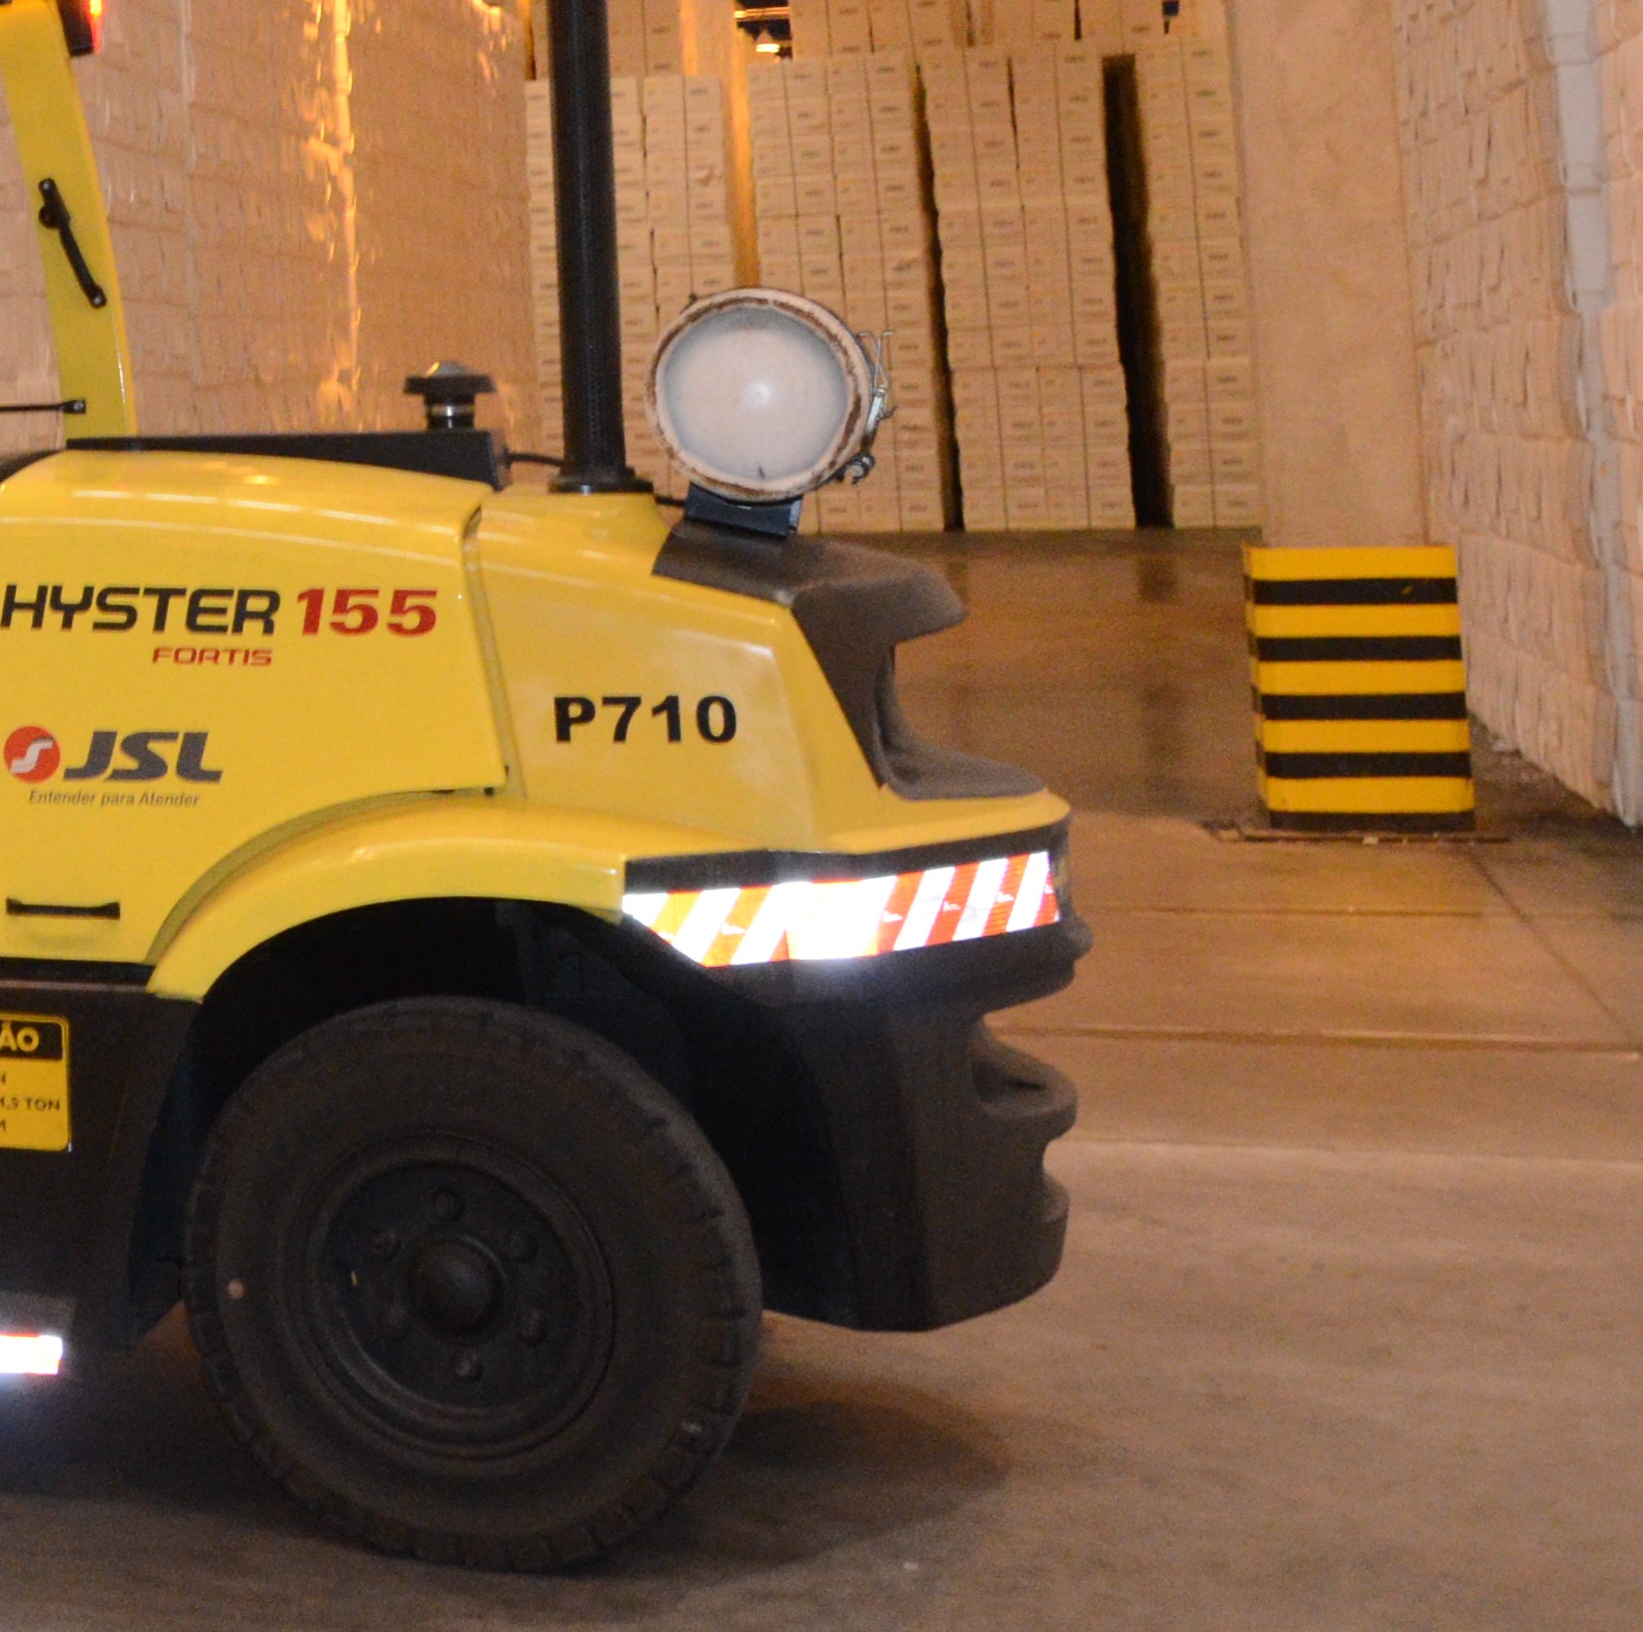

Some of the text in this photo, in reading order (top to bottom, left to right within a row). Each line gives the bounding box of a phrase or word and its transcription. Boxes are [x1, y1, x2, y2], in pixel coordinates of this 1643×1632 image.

[0, 584, 437, 638] HYSTER 155
[152, 647, 273, 666] FORTIS
[554, 695, 737, 744] P710
[63, 730, 223, 784] JSL
[29, 790, 199, 809] Entender para Atender
[24, 1098, 60, 1111] TON
